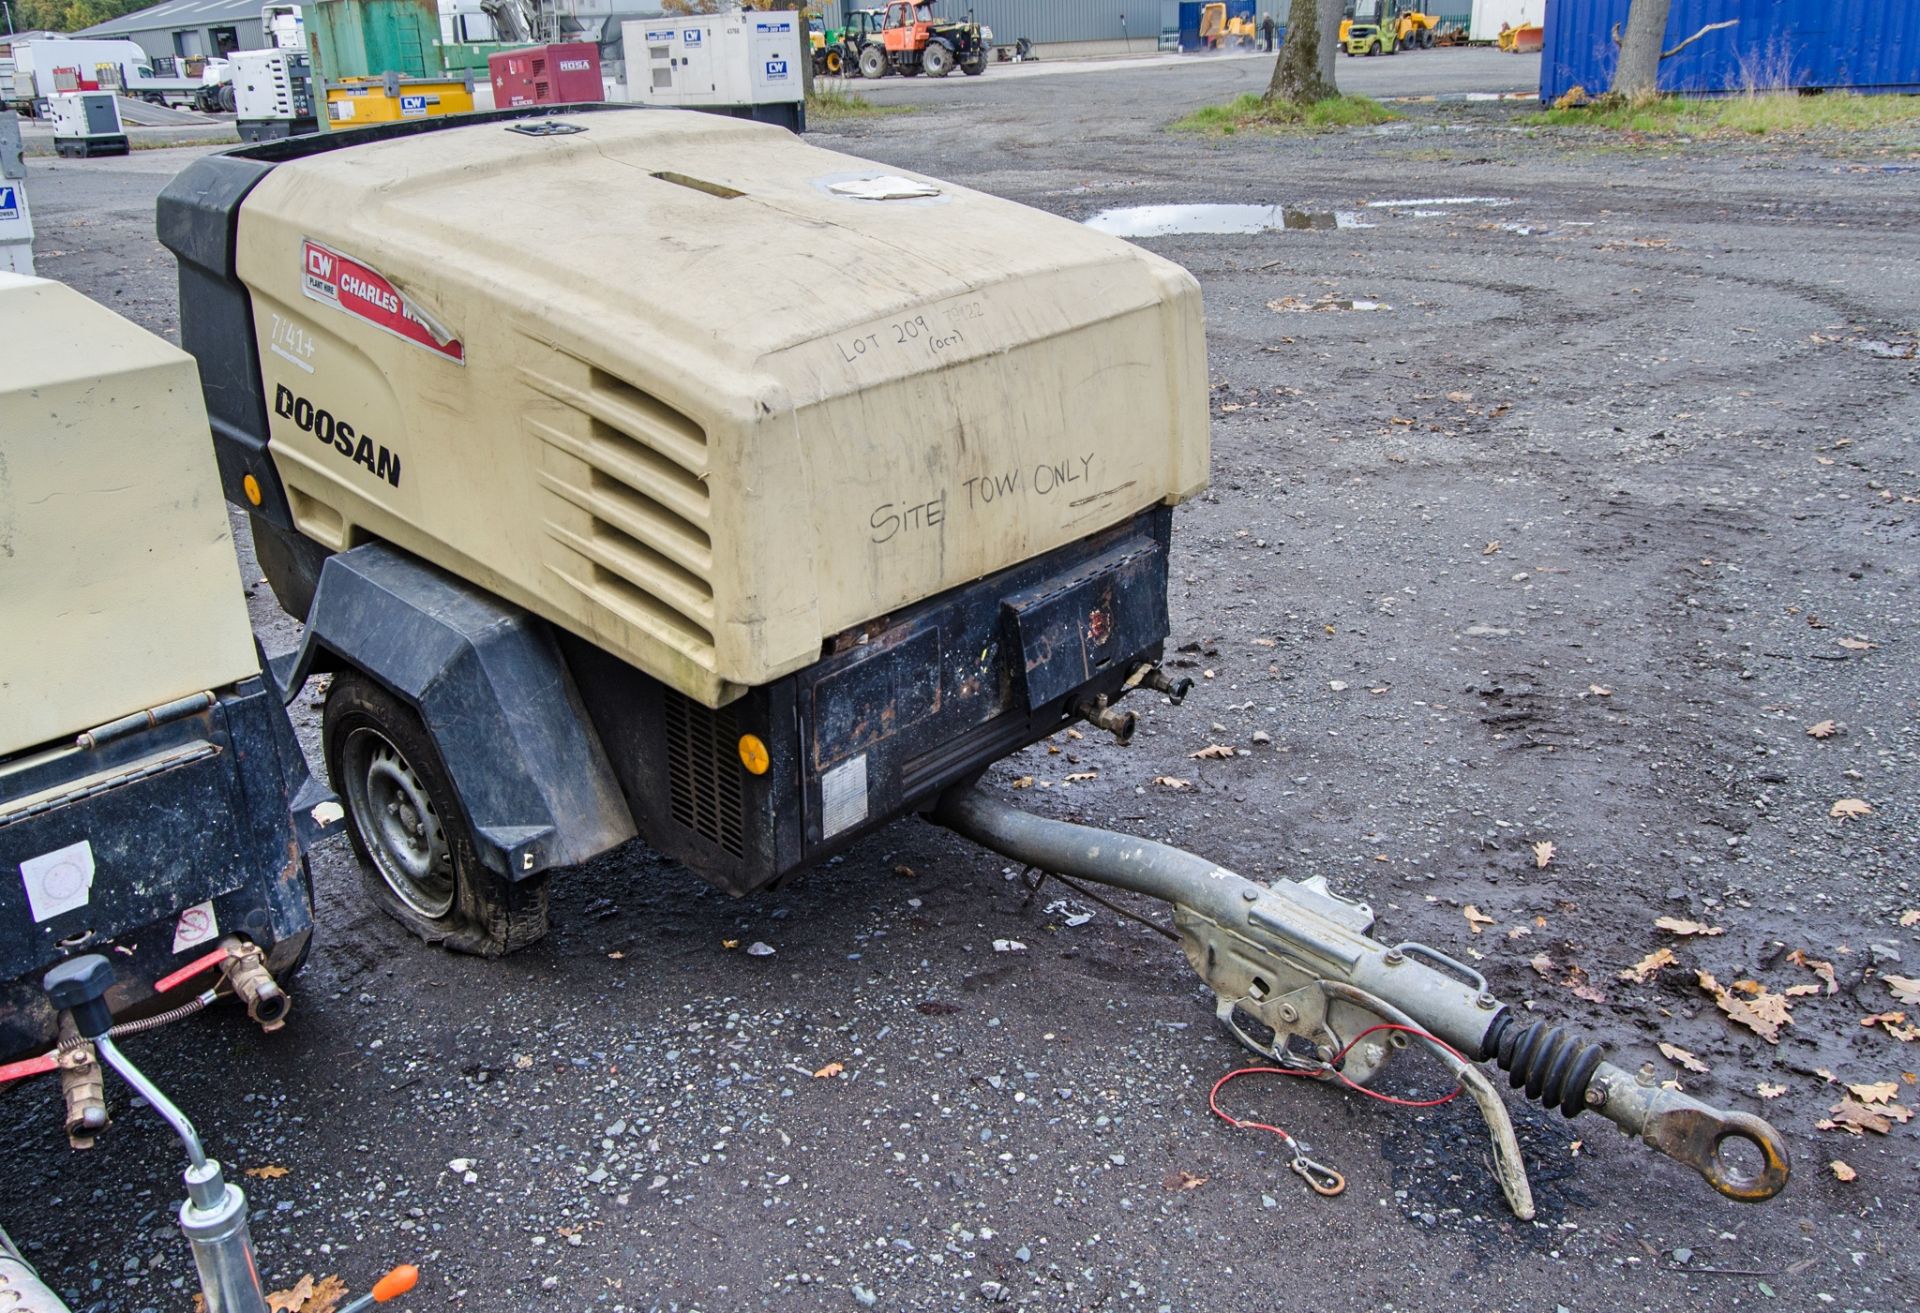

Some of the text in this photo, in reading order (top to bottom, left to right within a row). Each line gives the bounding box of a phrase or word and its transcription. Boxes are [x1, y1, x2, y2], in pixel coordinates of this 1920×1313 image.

[769, 62, 784, 73] CW
[404, 97, 422, 108] CW
[309, 250, 332, 279] CW
[310, 277, 334, 295] PLANT HIRE
[341, 274, 398, 314] CHARLES
[837, 315, 930, 363] LOT 209
[275, 382, 401, 488] DOOSAN
[962, 469, 1018, 509] TOW
[1034, 453, 1095, 495] ONLY
